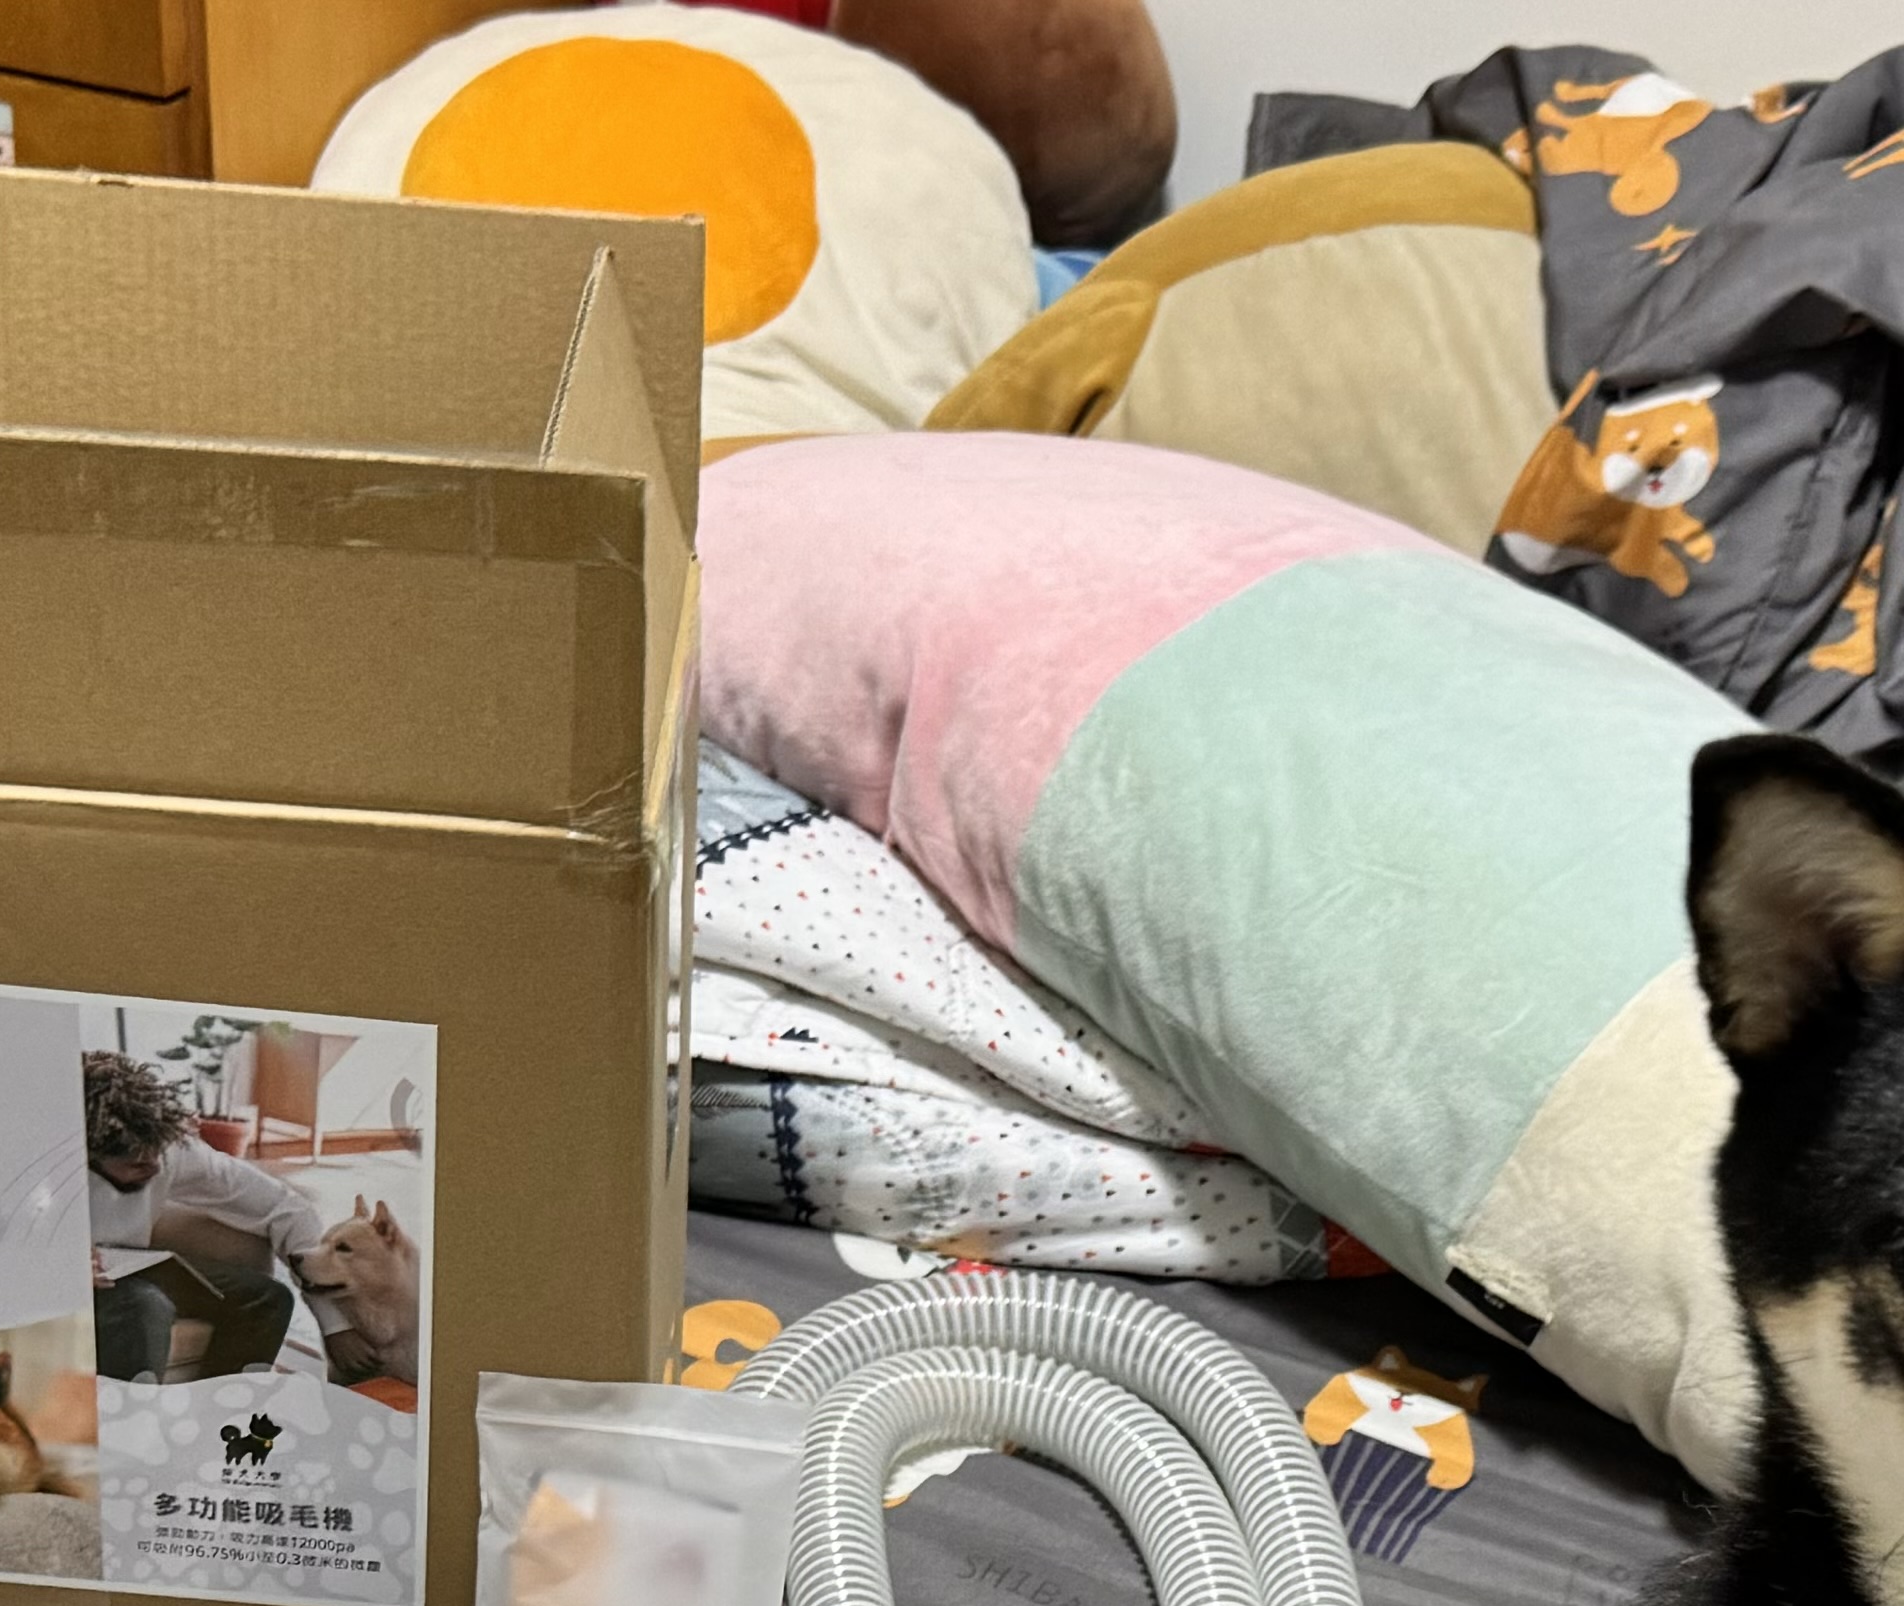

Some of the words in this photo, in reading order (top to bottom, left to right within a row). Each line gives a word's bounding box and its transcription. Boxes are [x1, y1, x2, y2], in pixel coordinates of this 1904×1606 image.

[153, 1492, 354, 1532] 多功能吸毛機
